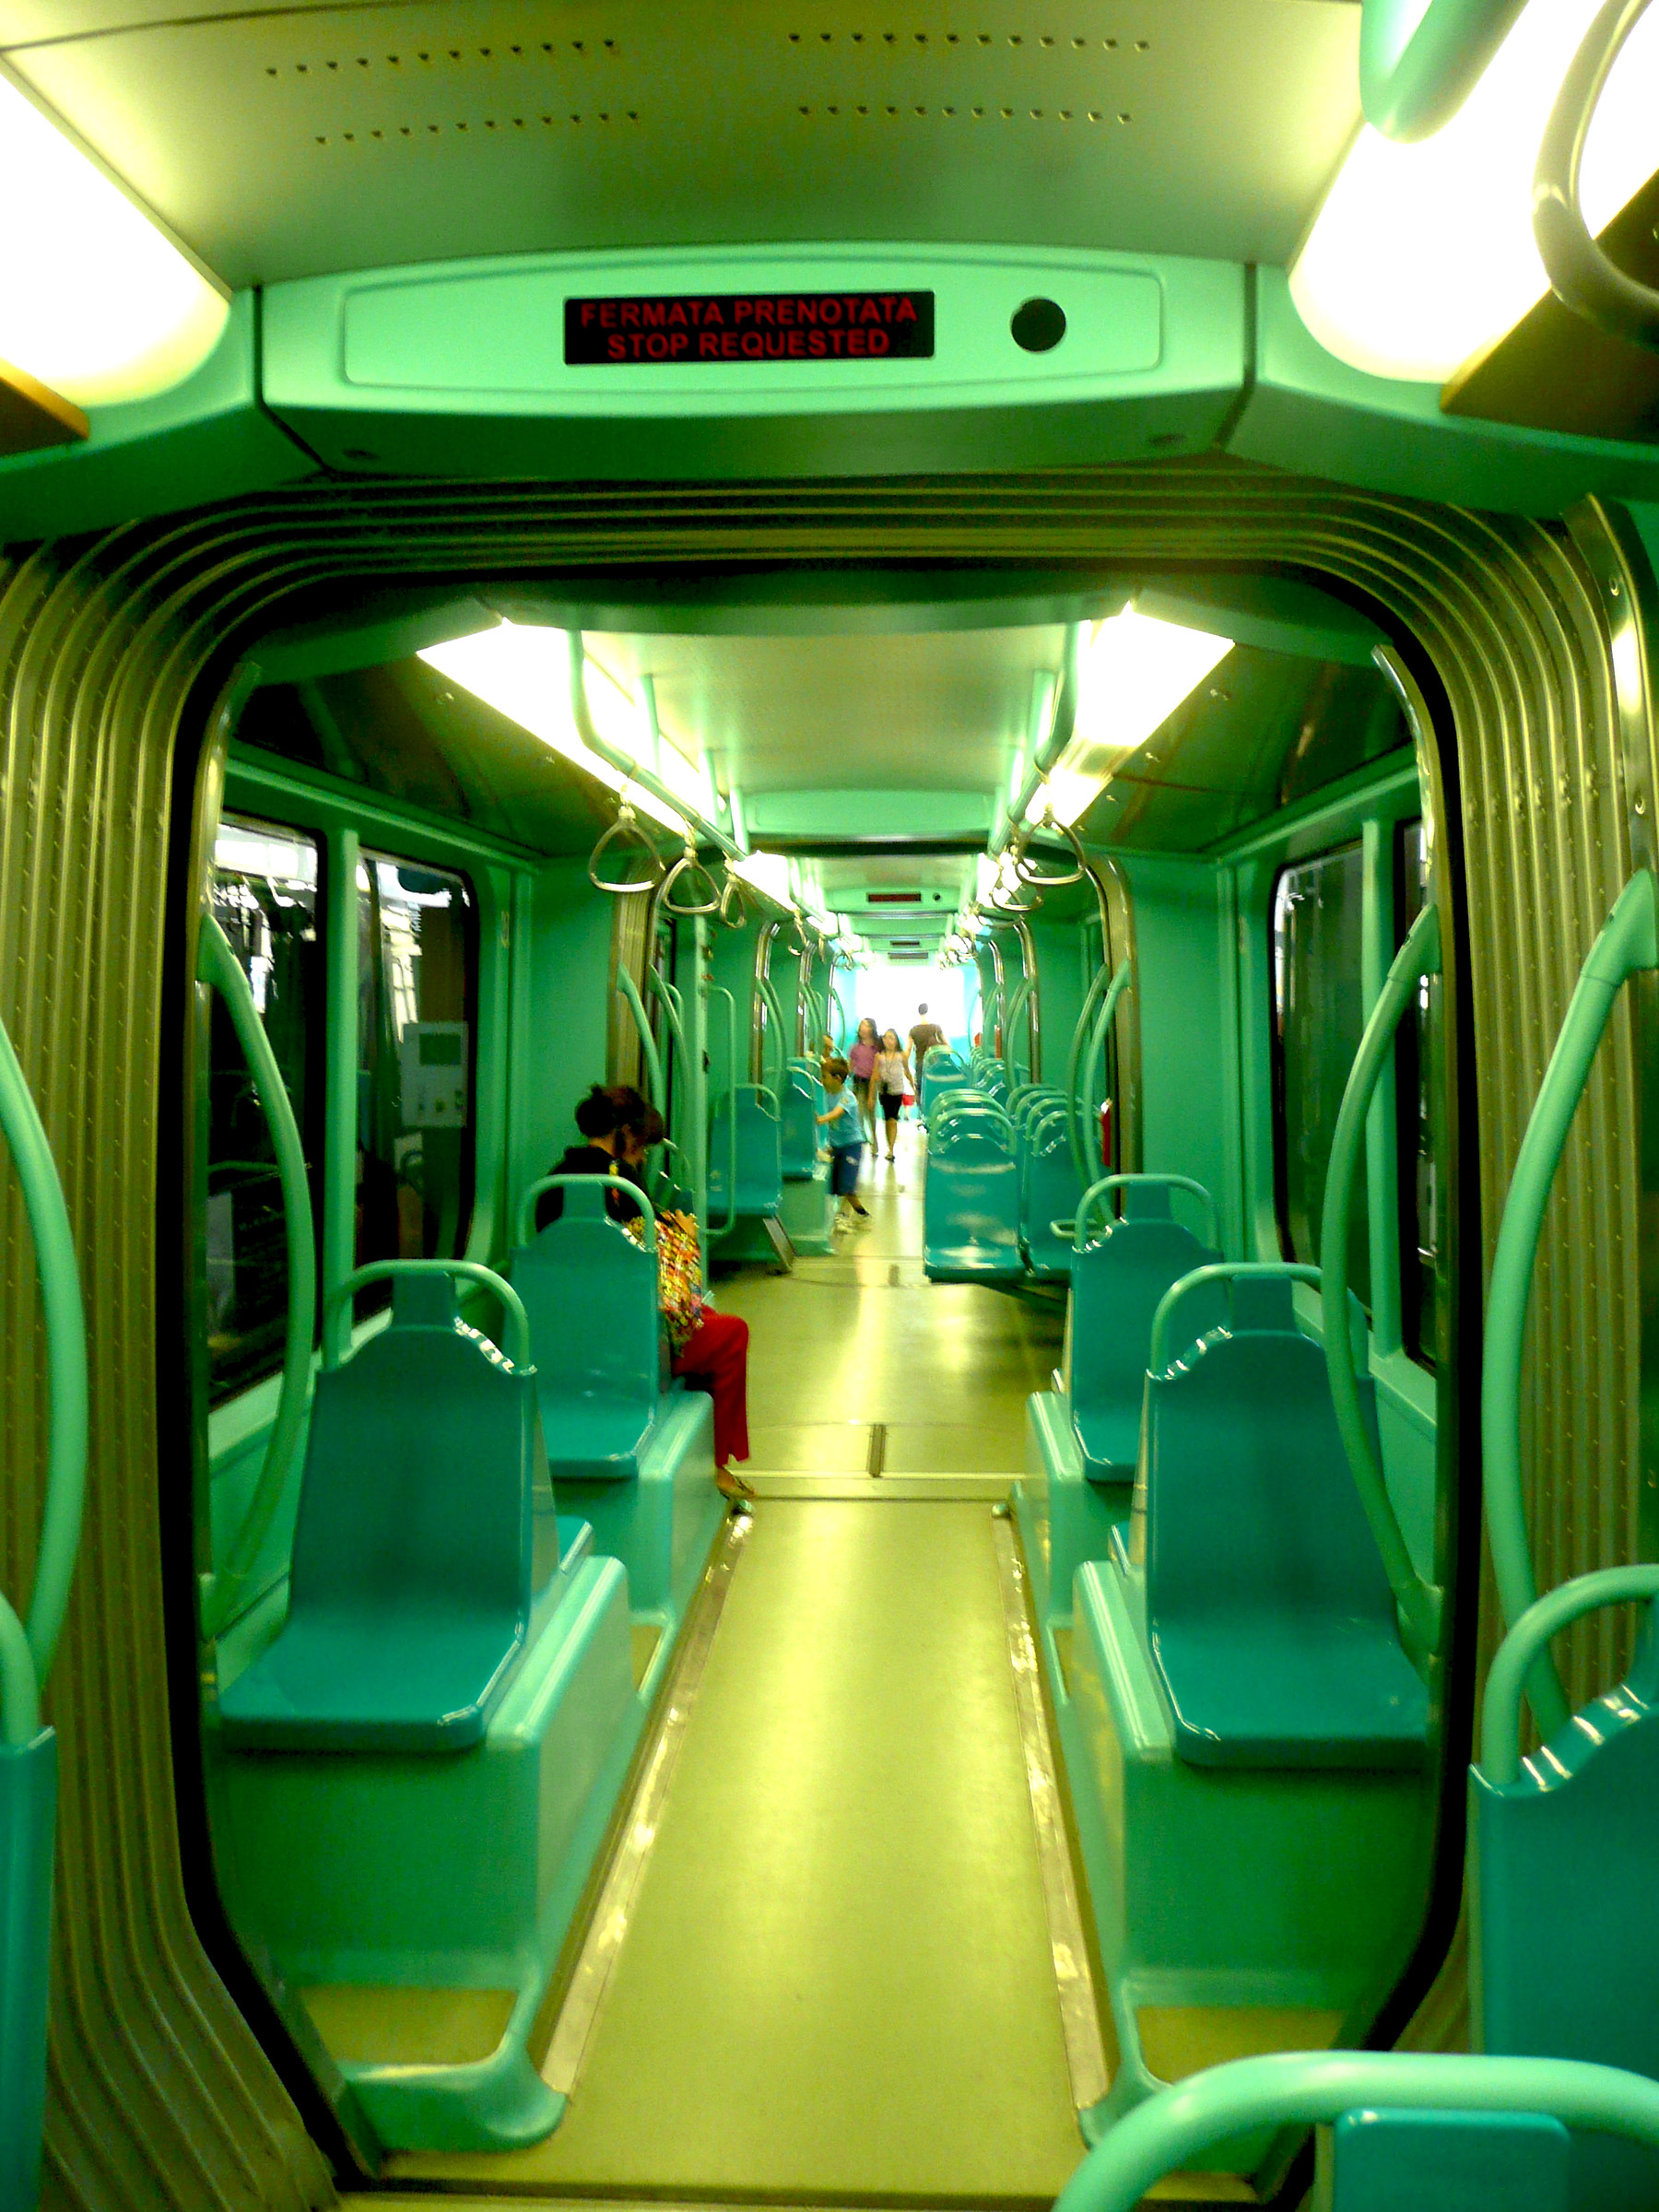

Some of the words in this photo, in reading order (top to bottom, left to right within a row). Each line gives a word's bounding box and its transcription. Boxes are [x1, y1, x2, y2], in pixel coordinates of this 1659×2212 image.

[580, 300, 724, 328] FERMATA
[734, 296, 918, 325] PRENOTATA
[606, 333, 689, 359] STOP
[698, 328, 890, 358] REQUESTED
